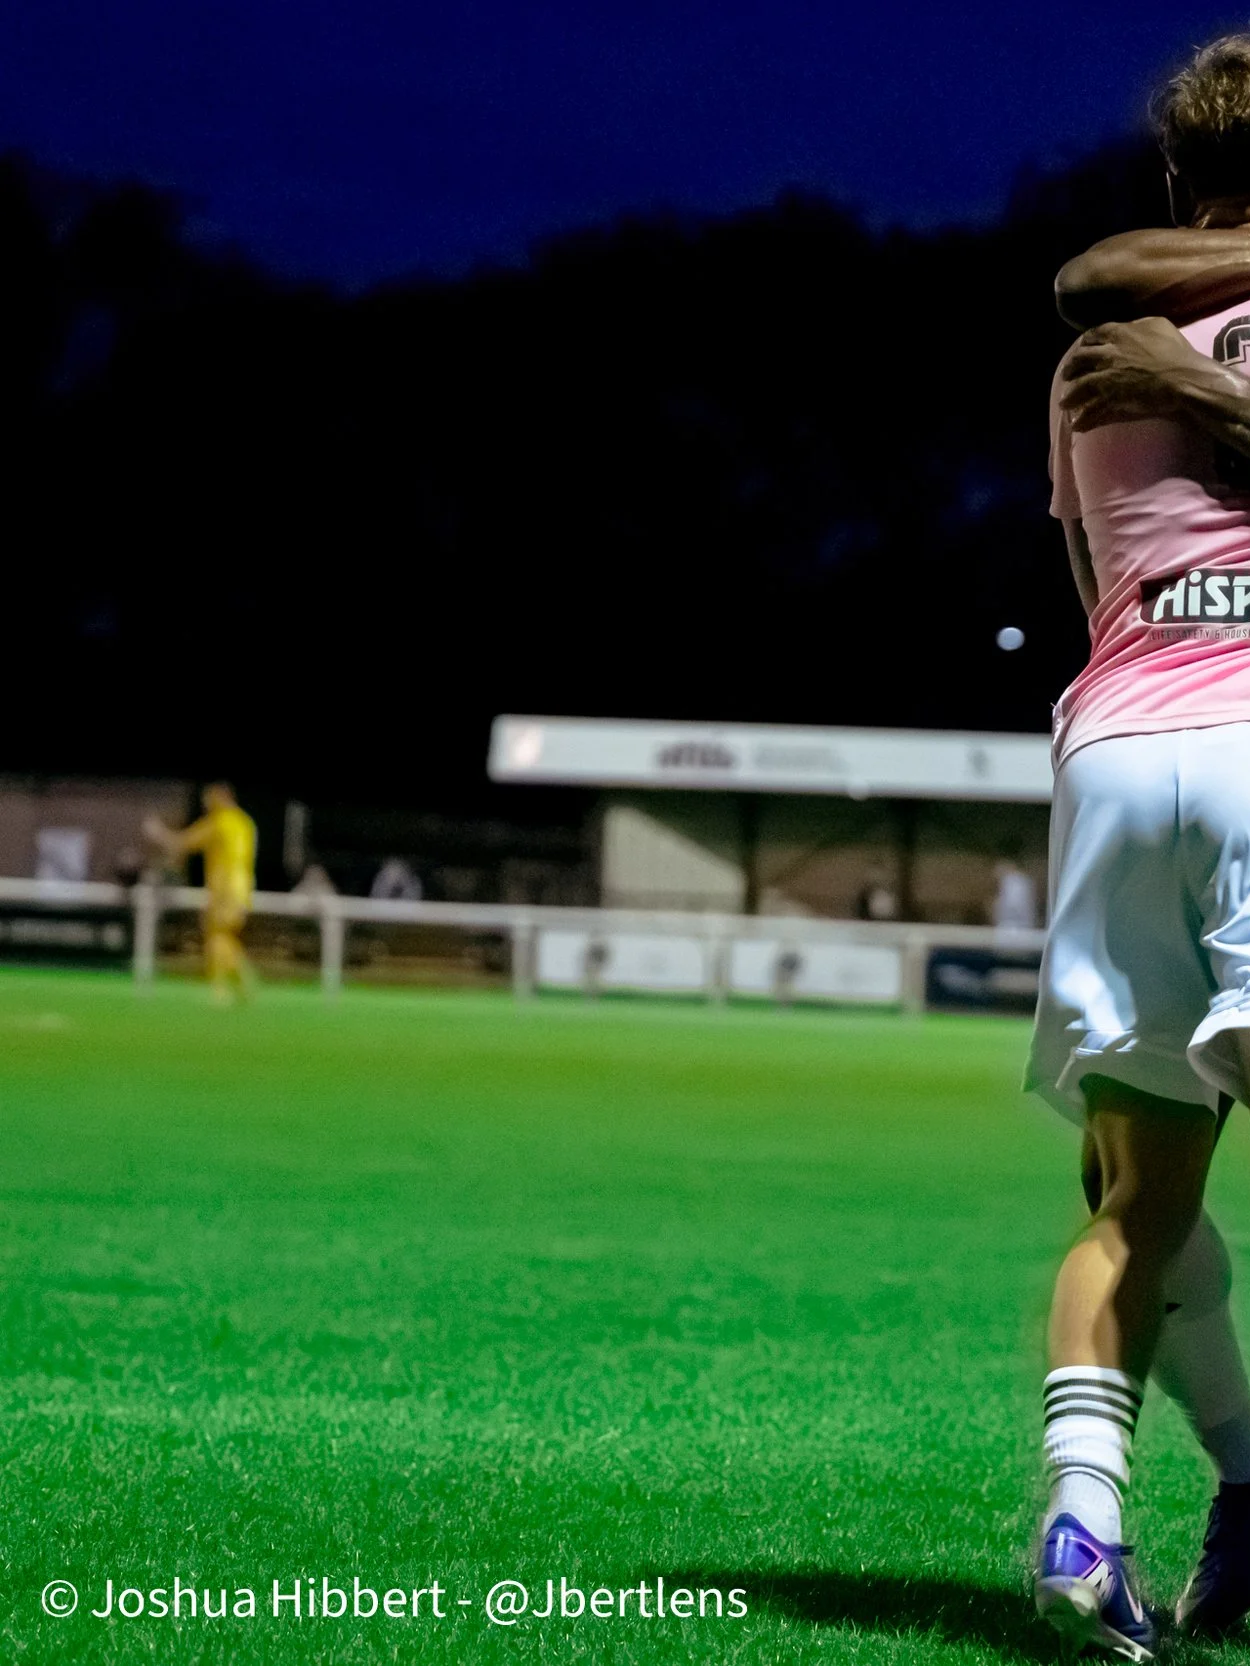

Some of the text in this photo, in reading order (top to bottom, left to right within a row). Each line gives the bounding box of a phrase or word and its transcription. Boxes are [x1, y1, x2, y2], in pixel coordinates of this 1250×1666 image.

[1150, 629, 1172, 641] LIFE
[1176, 629, 1210, 640] SAFETY
[1214, 628, 1220, 640] &
